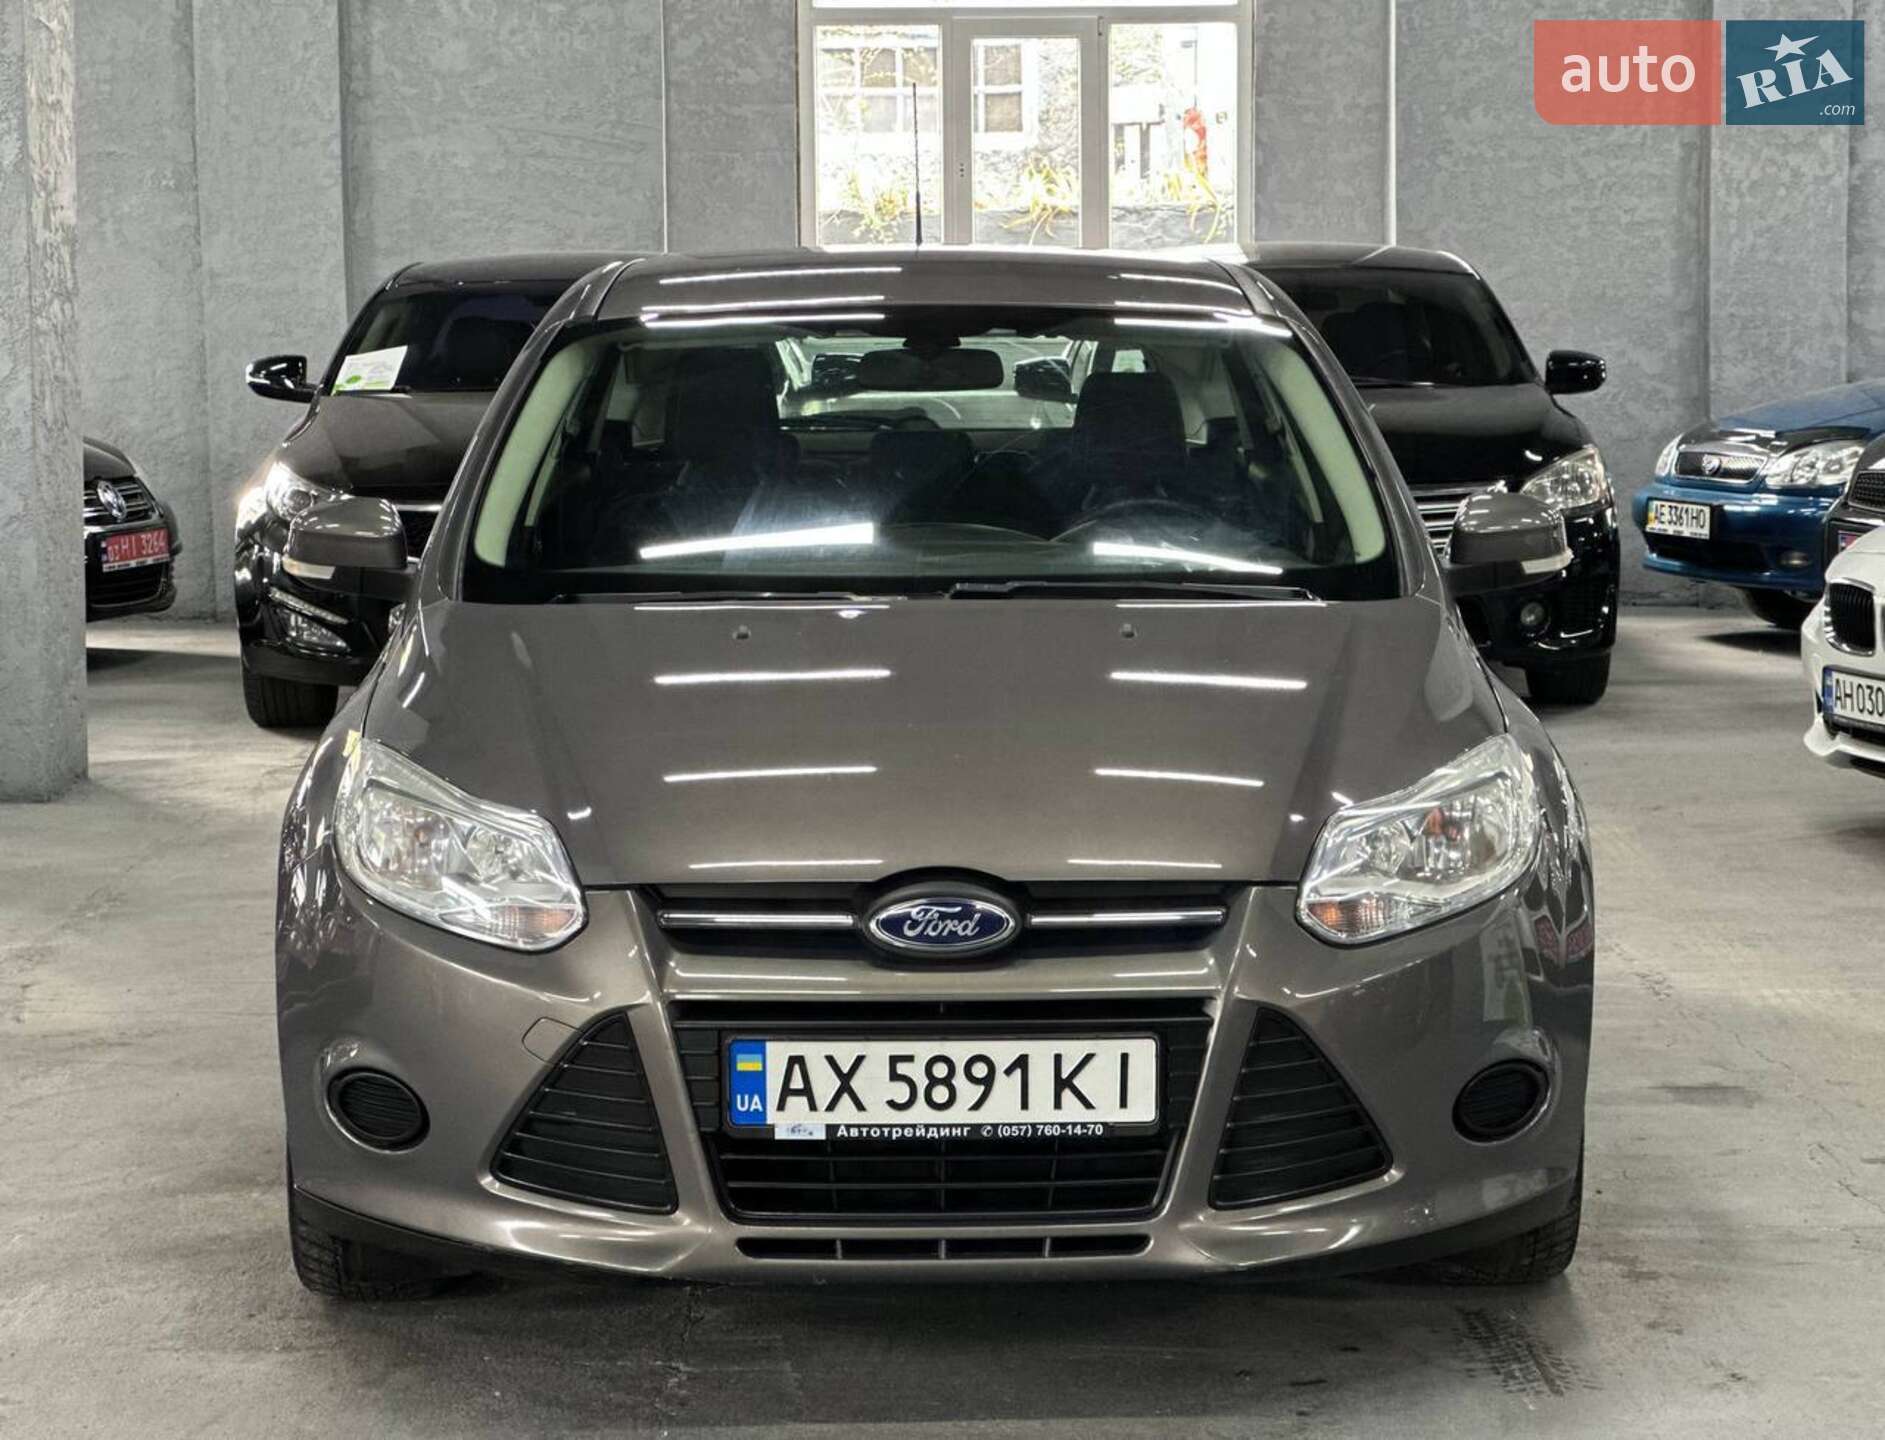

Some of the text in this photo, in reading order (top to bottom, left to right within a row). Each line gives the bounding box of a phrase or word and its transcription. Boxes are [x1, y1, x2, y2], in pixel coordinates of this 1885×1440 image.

[903, 905, 981, 937] Ford
[776, 1052, 1129, 1112] AX 5891 KI
[736, 1093, 763, 1112] UA
[837, 1123, 1104, 1140] Автотрейдинг (057) 760-14-70
